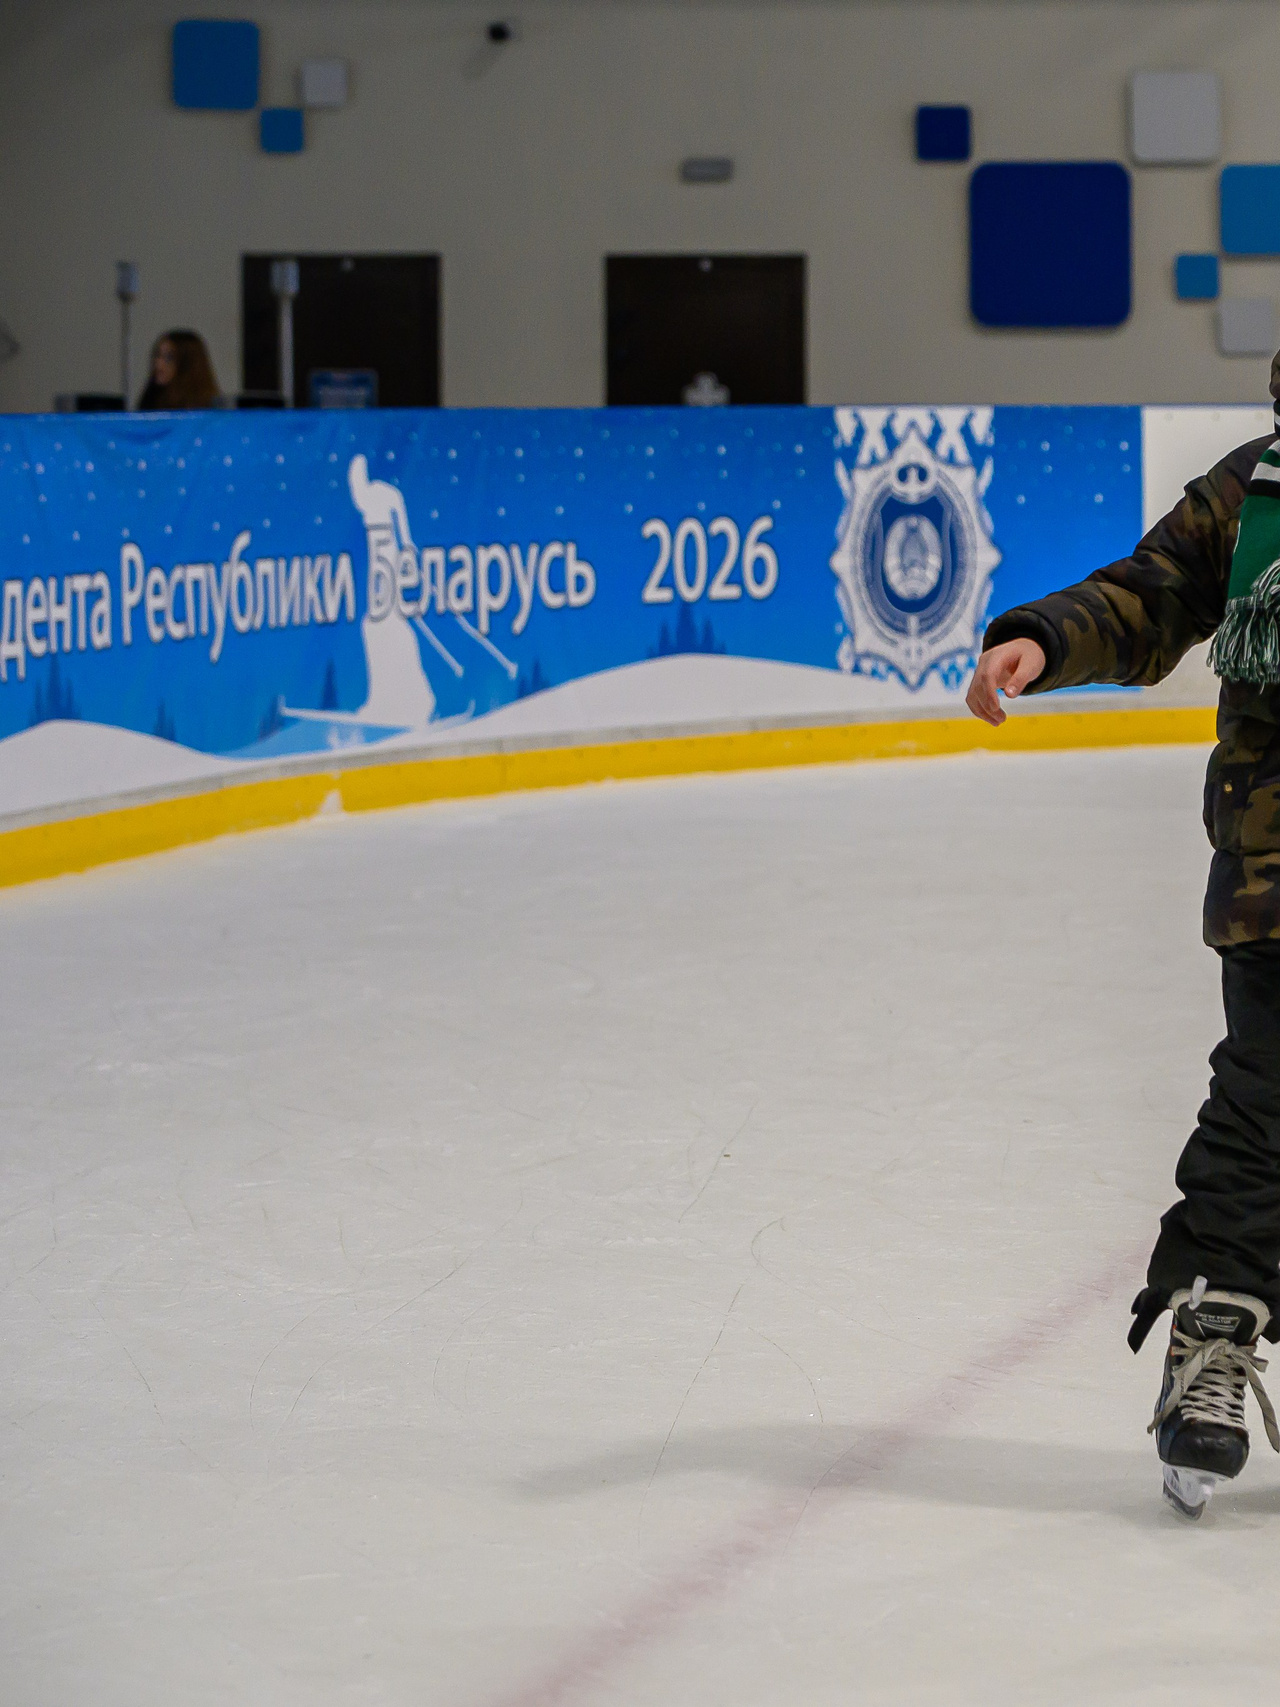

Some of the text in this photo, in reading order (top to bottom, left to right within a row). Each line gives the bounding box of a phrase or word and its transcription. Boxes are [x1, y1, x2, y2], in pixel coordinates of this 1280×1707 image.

[0, 516, 779, 681] дента Республики Беларусь 2026
